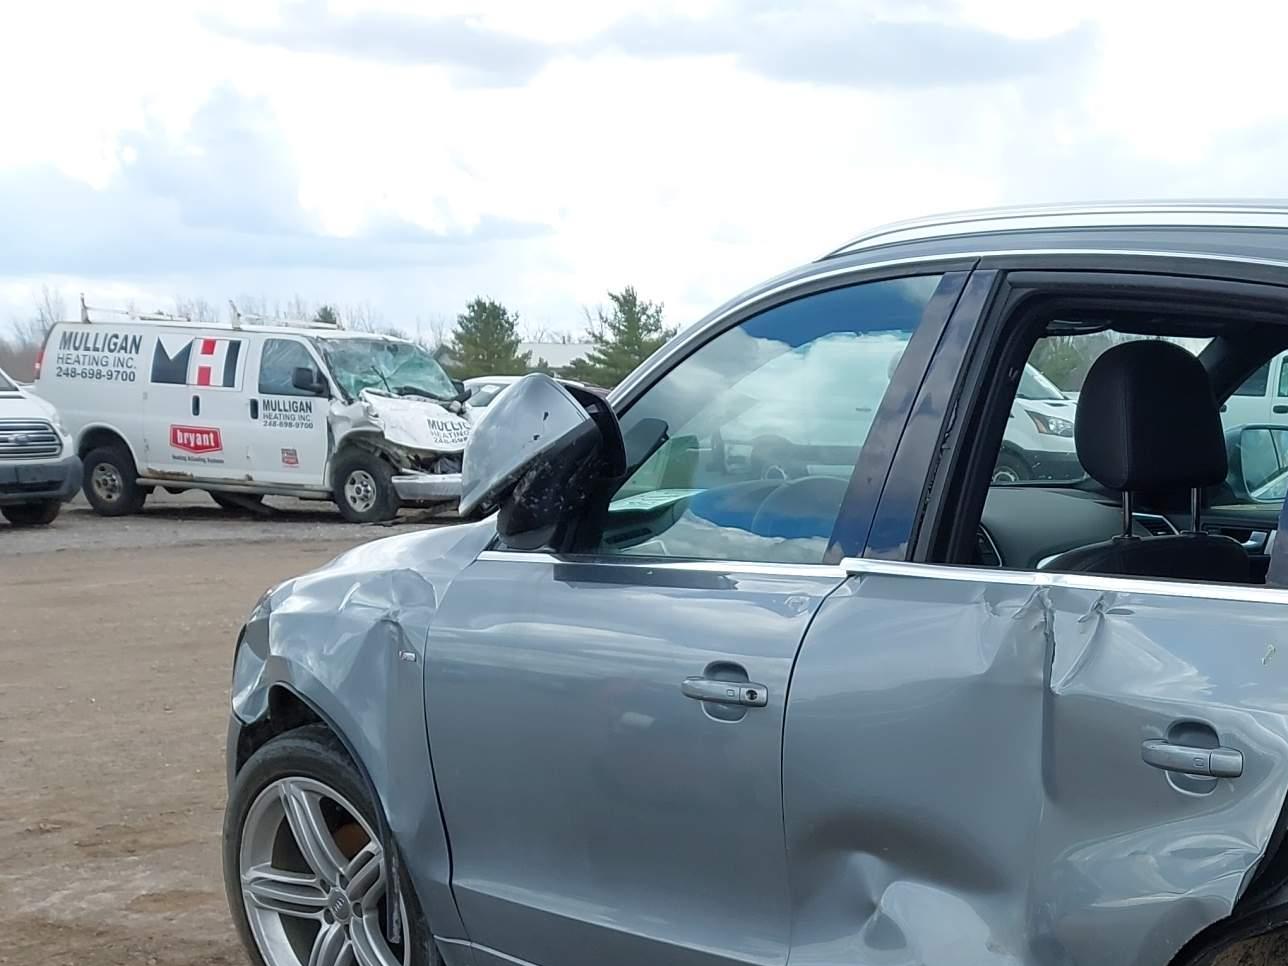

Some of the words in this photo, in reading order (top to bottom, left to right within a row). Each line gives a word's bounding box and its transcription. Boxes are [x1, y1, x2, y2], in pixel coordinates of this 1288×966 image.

[58, 331, 143, 355] MULLIGAN
[56, 353, 109, 367] HEATING
[112, 356, 137, 369] INC.
[56, 367, 136, 382] 248-698-9700
[262, 399, 313, 413] MULLIGAN
[262, 413, 296, 421] HEATING
[176, 429, 216, 447] bryant
